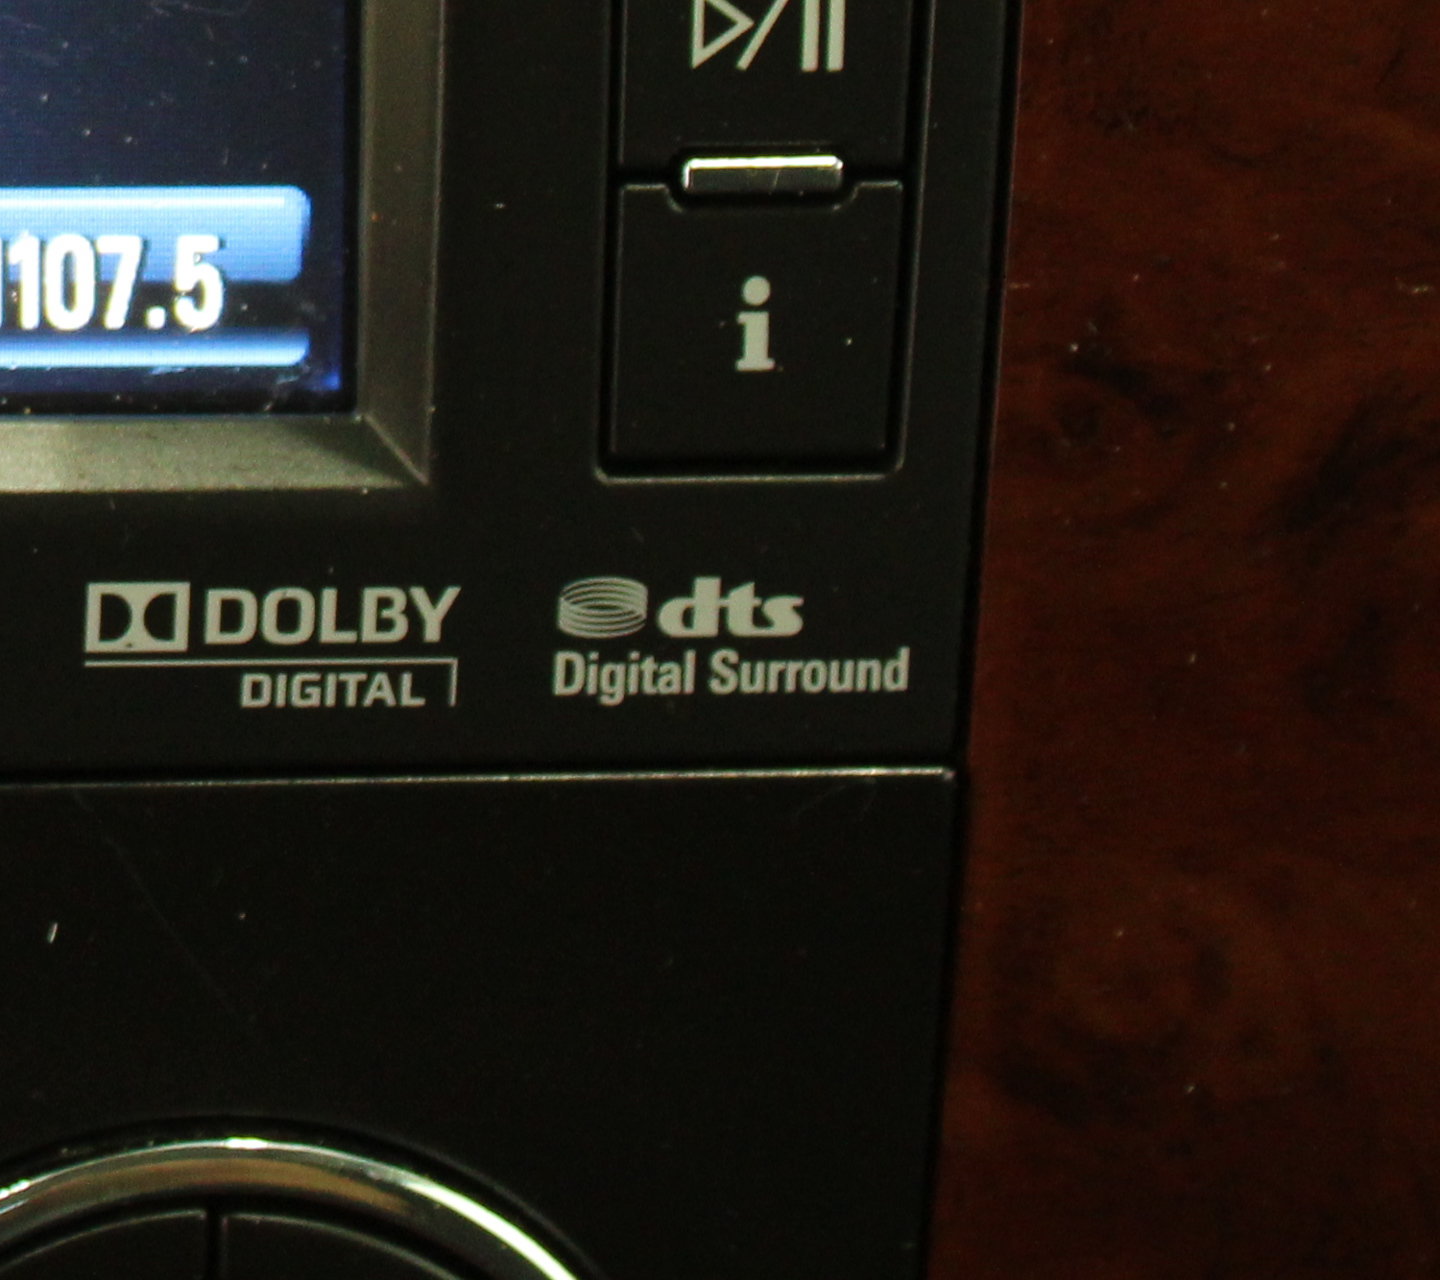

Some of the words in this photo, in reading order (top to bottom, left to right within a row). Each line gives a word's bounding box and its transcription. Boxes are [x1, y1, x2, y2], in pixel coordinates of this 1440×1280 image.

[205, 587, 460, 644] DOLBY
[657, 576, 804, 637] dts
[240, 672, 425, 709] DIGITAL
[554, 651, 695, 706] Digital
[709, 648, 910, 698] Surround
